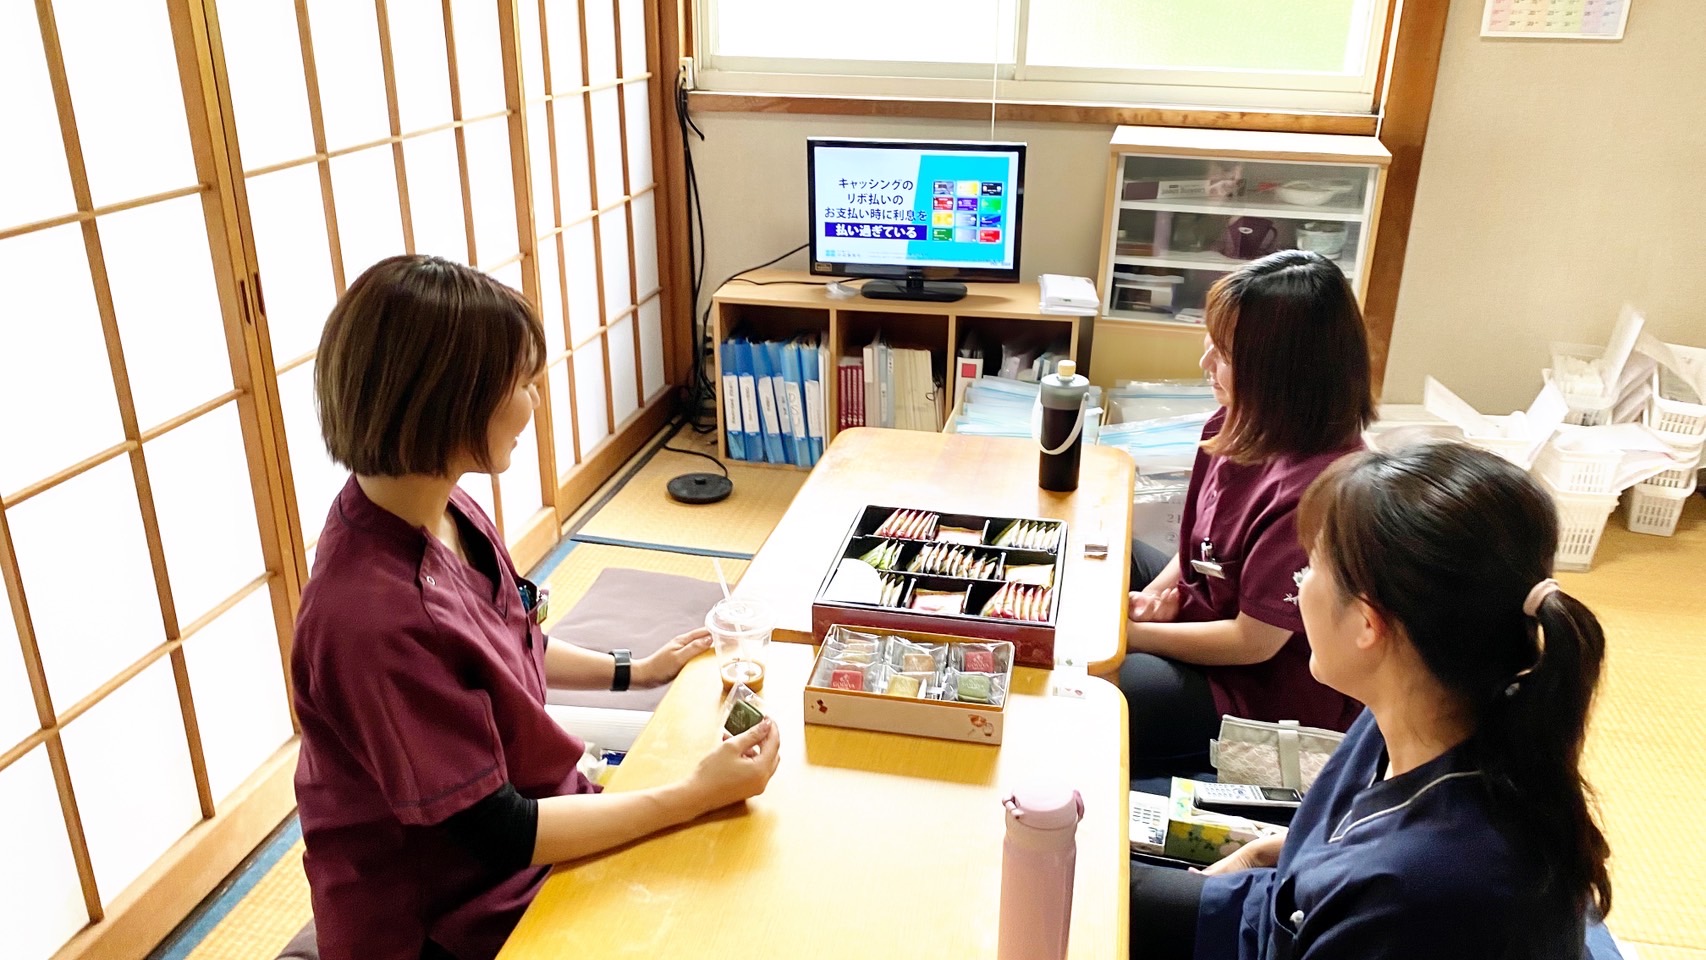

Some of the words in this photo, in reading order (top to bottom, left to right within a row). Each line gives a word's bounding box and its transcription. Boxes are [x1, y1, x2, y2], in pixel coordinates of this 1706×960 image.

[838, 178, 914, 191] キャッシングの
[847, 193, 904, 206] リボ払いの
[824, 207, 927, 221] お支払い時に利息を
[835, 224, 917, 238] 払い過ぎている
